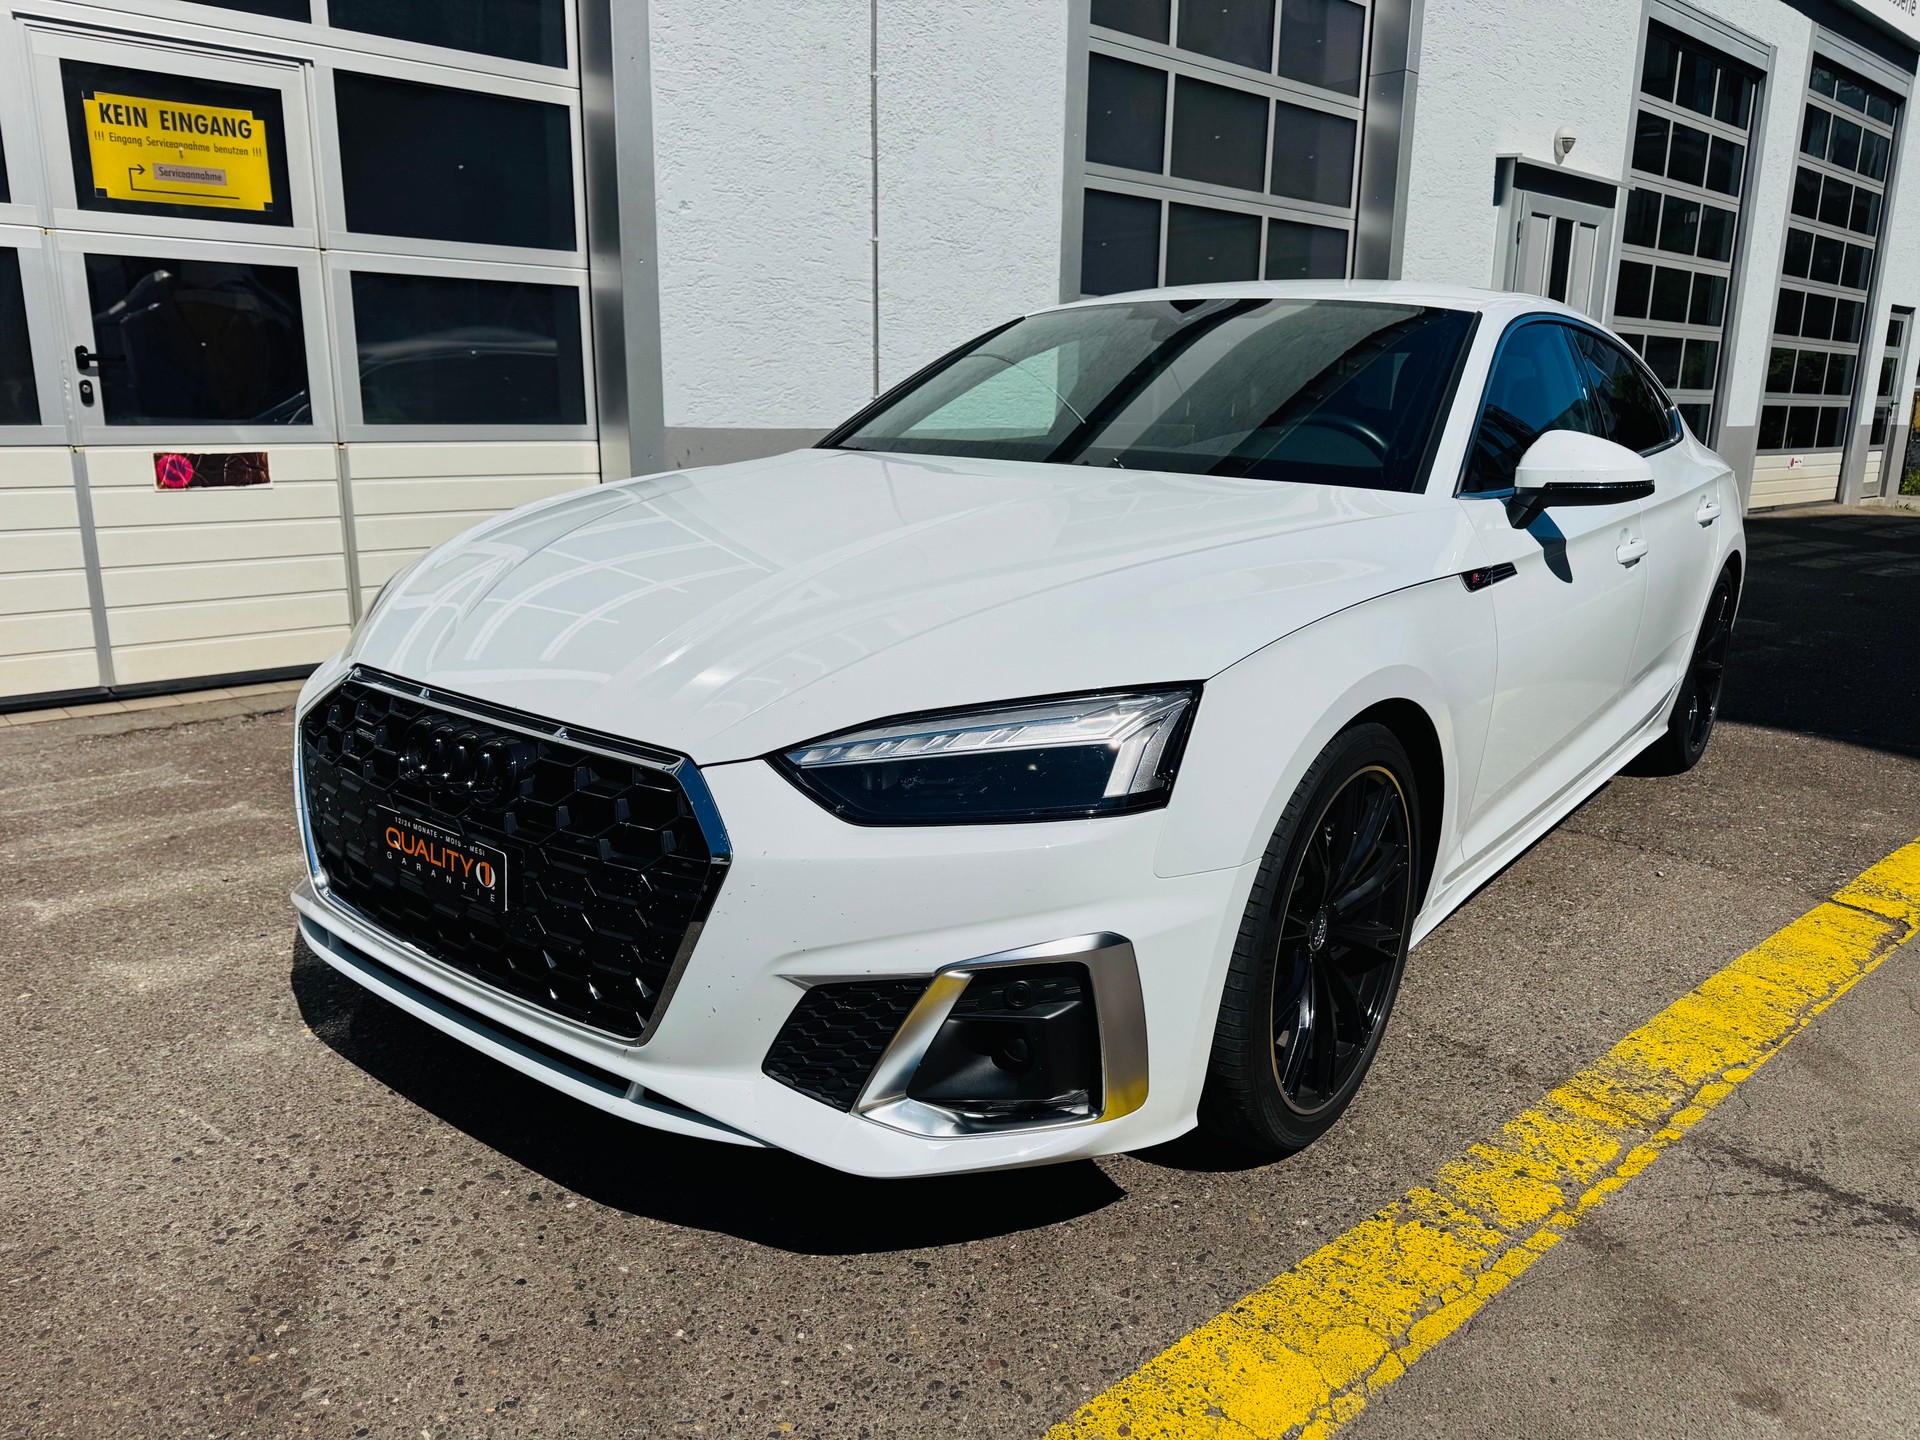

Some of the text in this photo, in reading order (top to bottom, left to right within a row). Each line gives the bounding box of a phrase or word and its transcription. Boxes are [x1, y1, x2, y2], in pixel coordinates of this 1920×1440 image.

[98, 102, 253, 140] KEIN EINGANG
[109, 132, 143, 148] Eingang
[146, 136, 211, 153] Serviceannahme
[213, 142, 249, 156] benutzen
[158, 166, 223, 182] Serviceannahme
[412, 823, 438, 839] MONATE
[445, 835, 462, 848] MOIS
[469, 844, 485, 857] MESI
